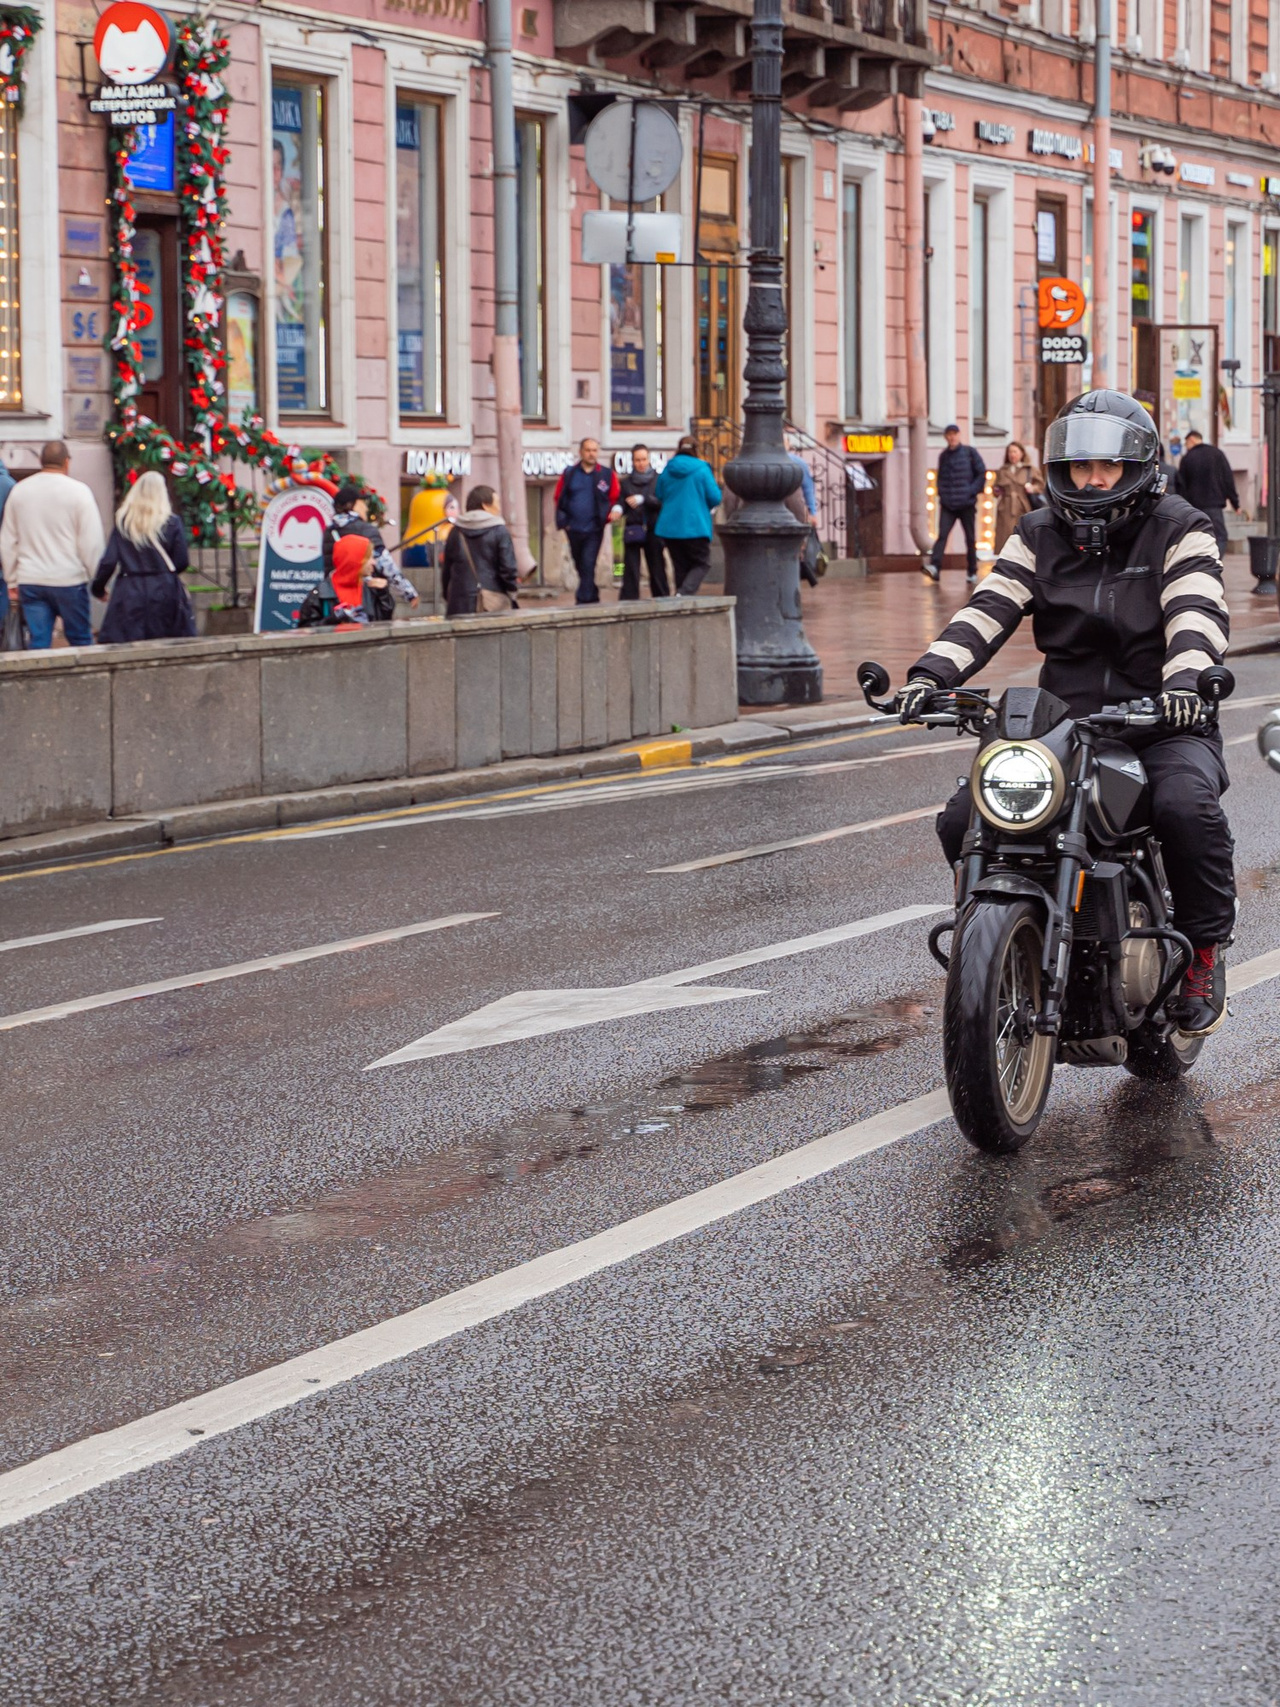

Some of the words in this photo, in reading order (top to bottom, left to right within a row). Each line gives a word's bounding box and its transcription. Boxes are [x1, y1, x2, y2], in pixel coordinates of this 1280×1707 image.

[100, 83, 166, 99] МАГАЗИН
[110, 110, 157, 125] КОТОВ
[1042, 336, 1082, 349] DODO
[1042, 350, 1084, 362] PIZZA
[406, 450, 471, 475] ПОДАРКИ
[270, 569, 325, 581] МАГАЗИН
